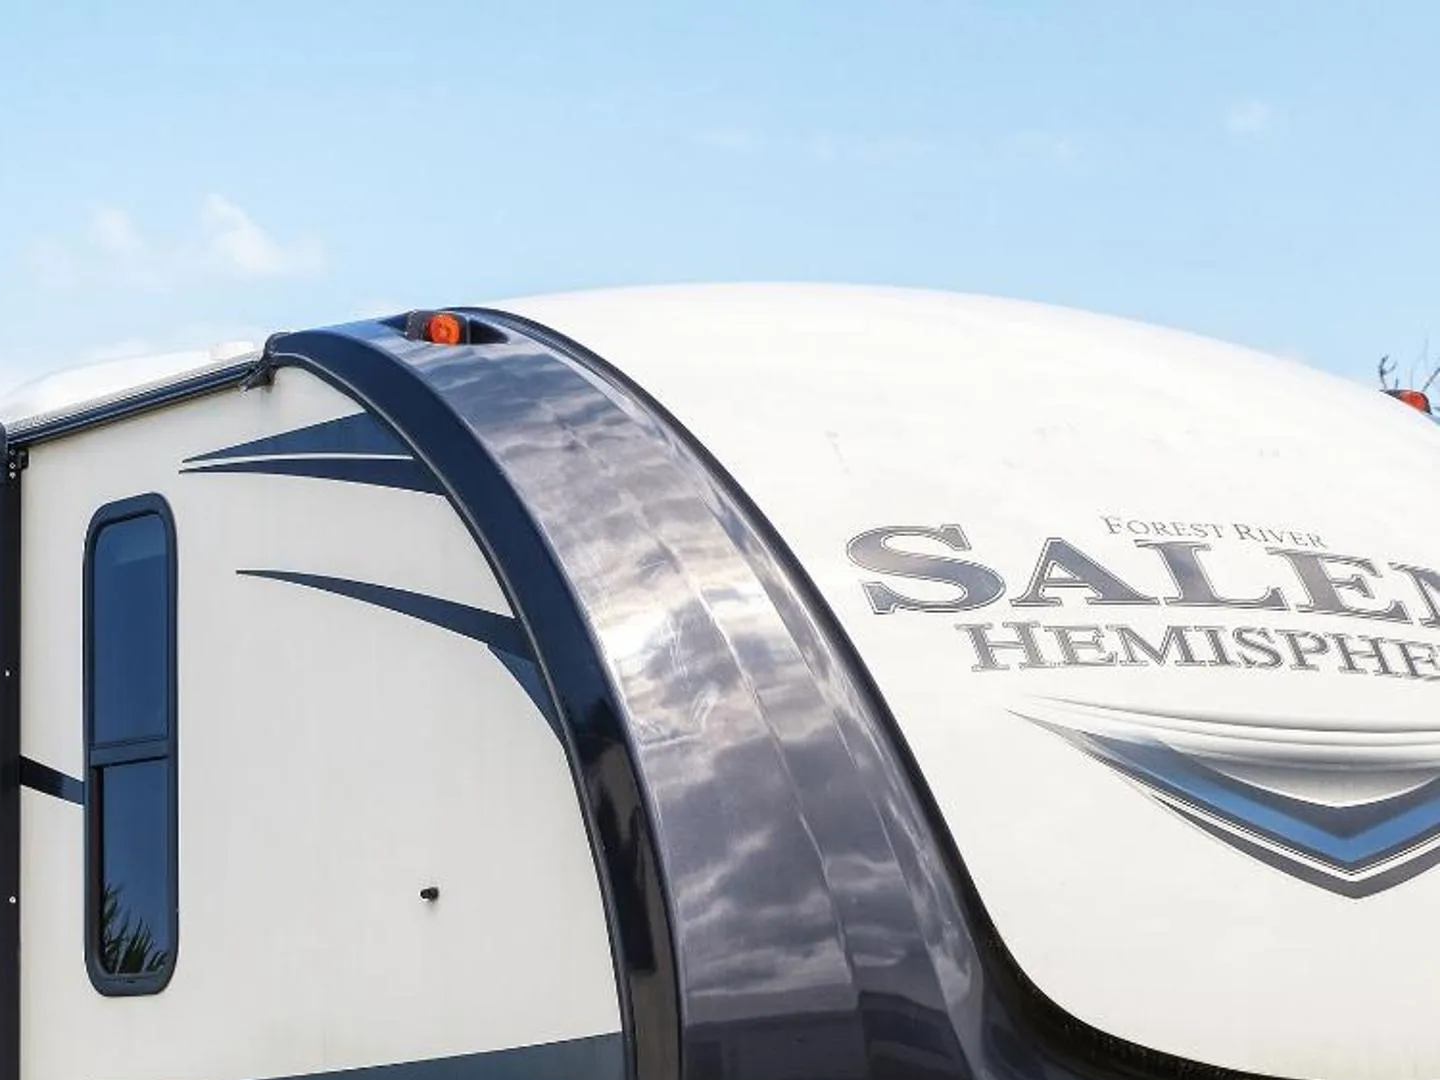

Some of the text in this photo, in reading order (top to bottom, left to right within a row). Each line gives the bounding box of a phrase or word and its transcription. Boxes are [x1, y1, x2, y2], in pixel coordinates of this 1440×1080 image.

[1100, 513, 1328, 548] FOREST RIVER
[846, 524, 1440, 629] SALE
